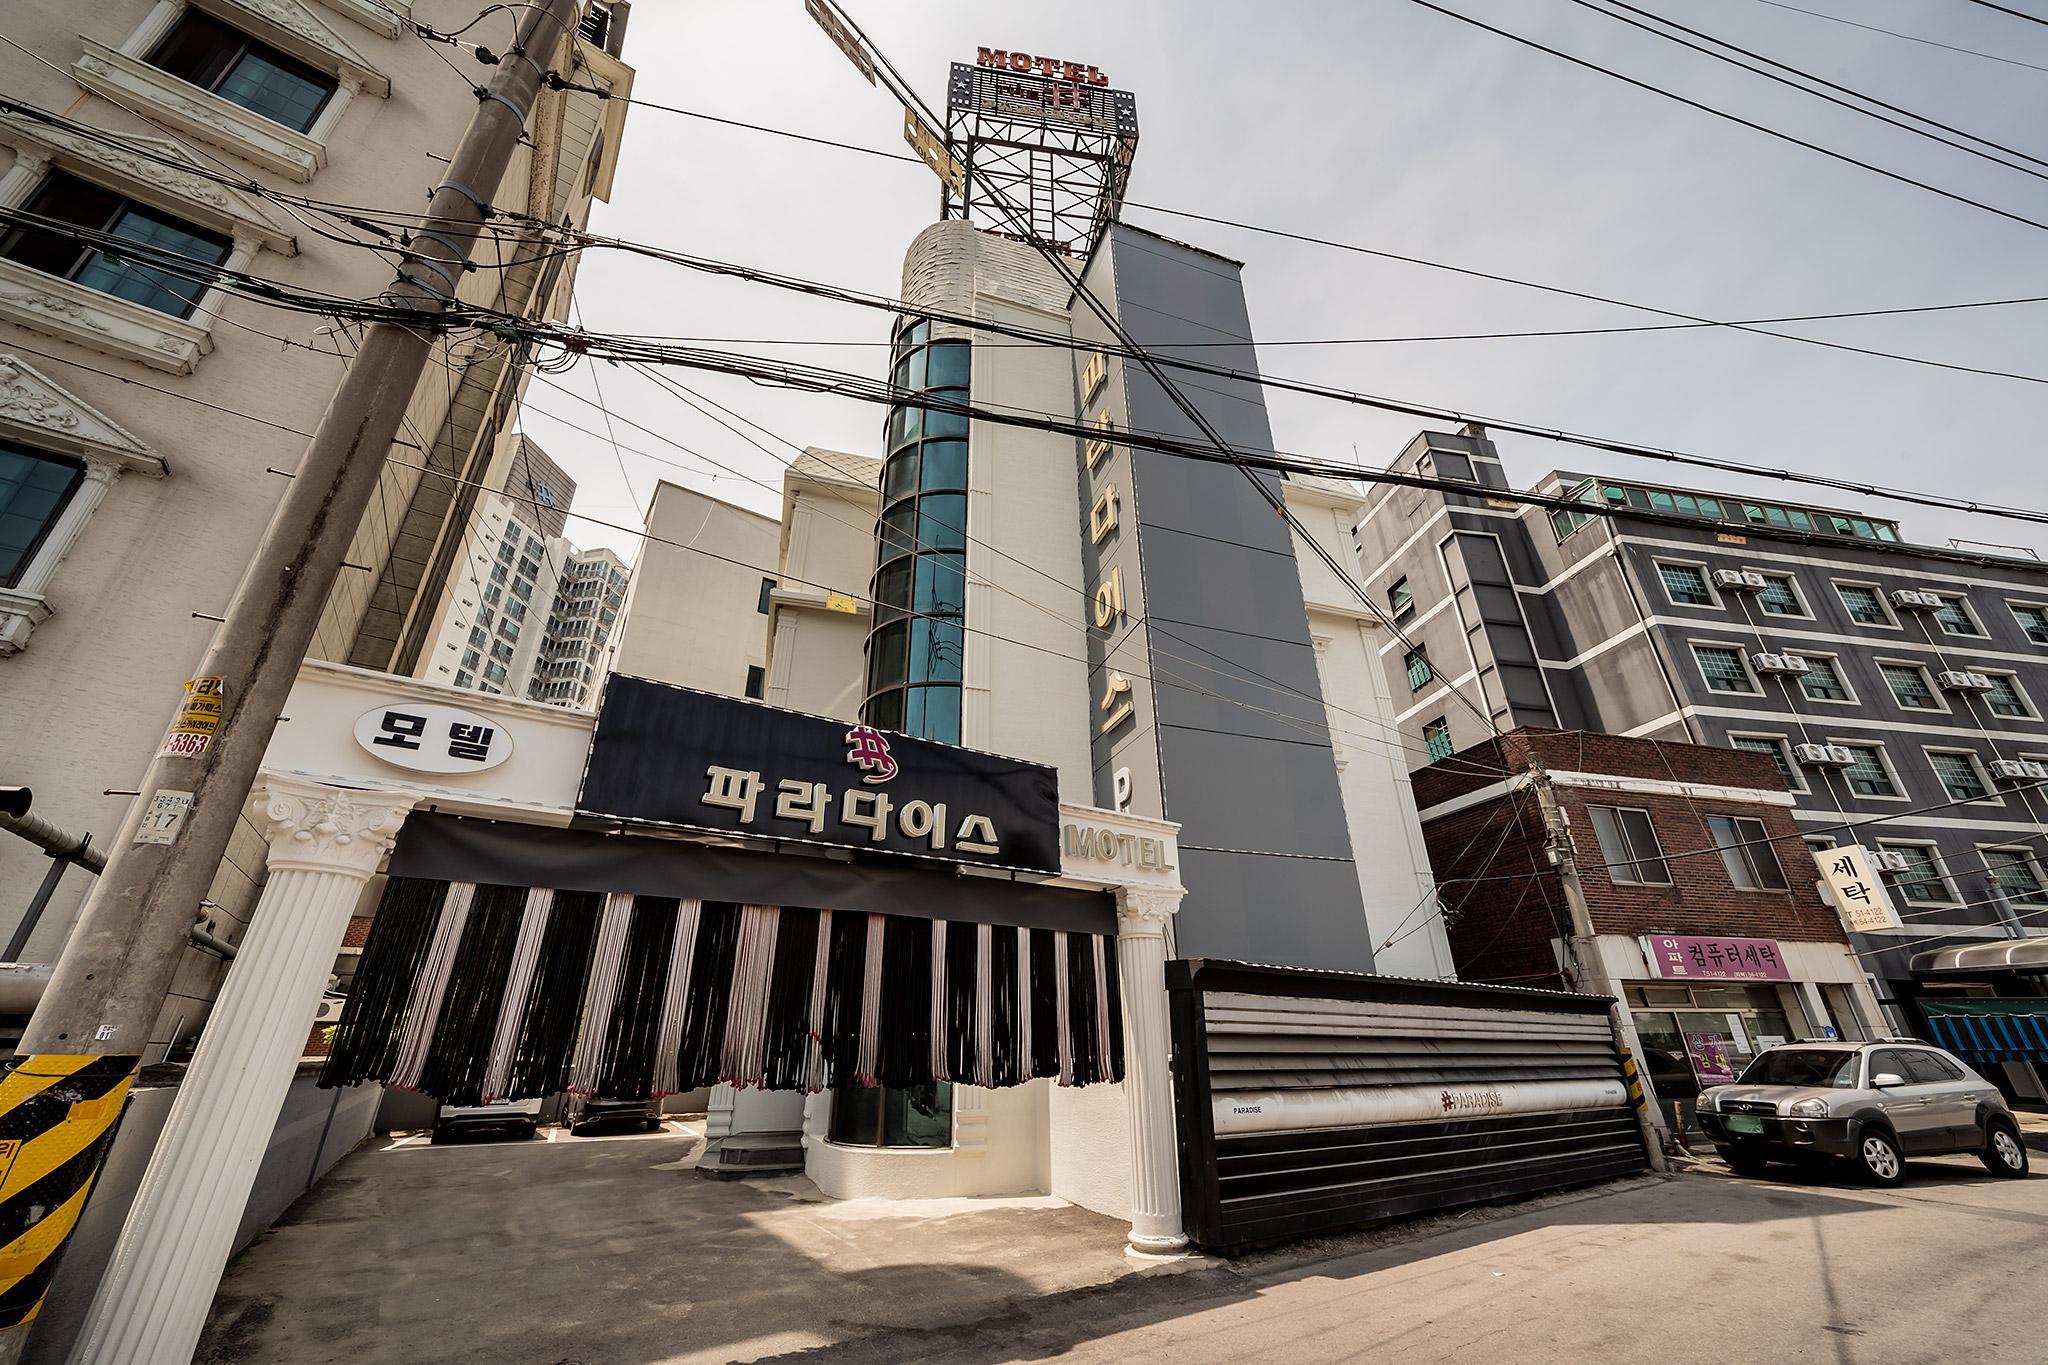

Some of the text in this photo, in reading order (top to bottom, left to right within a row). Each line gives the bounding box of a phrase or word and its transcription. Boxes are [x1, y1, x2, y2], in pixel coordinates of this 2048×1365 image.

[977, 46, 1108, 87] MOTEL
[373, 711, 494, 762] 모텔
[701, 765, 999, 854] 파라다이스
[1064, 824, 1174, 873] MOTEL
[1832, 856, 1870, 904] 세탁
[1663, 939, 1688, 975] 아파트
[1688, 943, 1777, 969] 컴퓨터세탁
[1233, 1106, 1262, 1114] PARADISE
